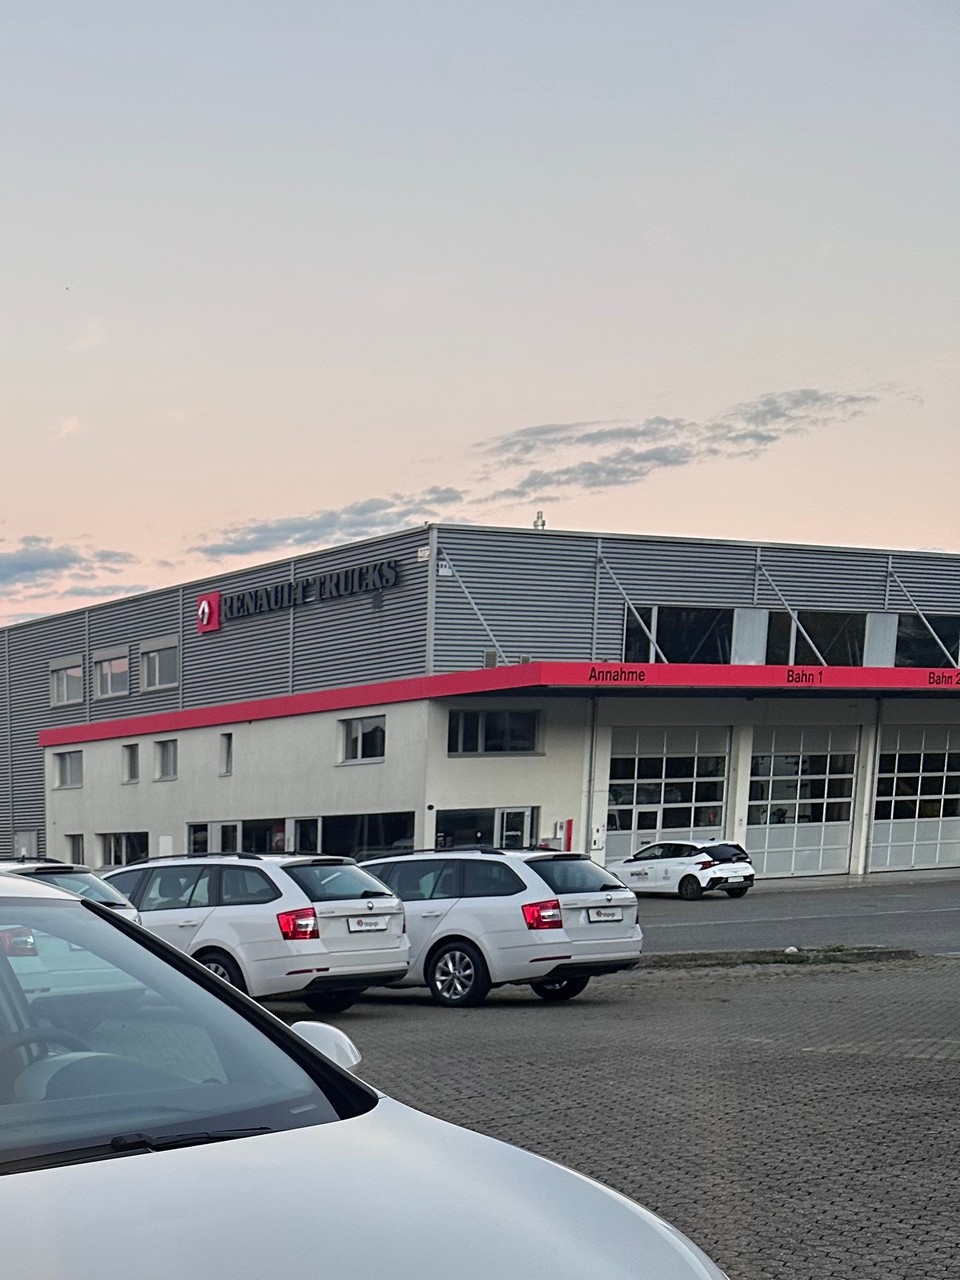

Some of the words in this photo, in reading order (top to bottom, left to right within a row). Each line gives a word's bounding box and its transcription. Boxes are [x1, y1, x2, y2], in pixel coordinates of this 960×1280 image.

[222, 579, 308, 620] RENAULT
[309, 560, 399, 600] TRUCKS
[589, 667, 645, 682] Annahme
[787, 670, 815, 683] Bahn
[818, 671, 823, 683] 1
[928, 672, 953, 685] Bahn
